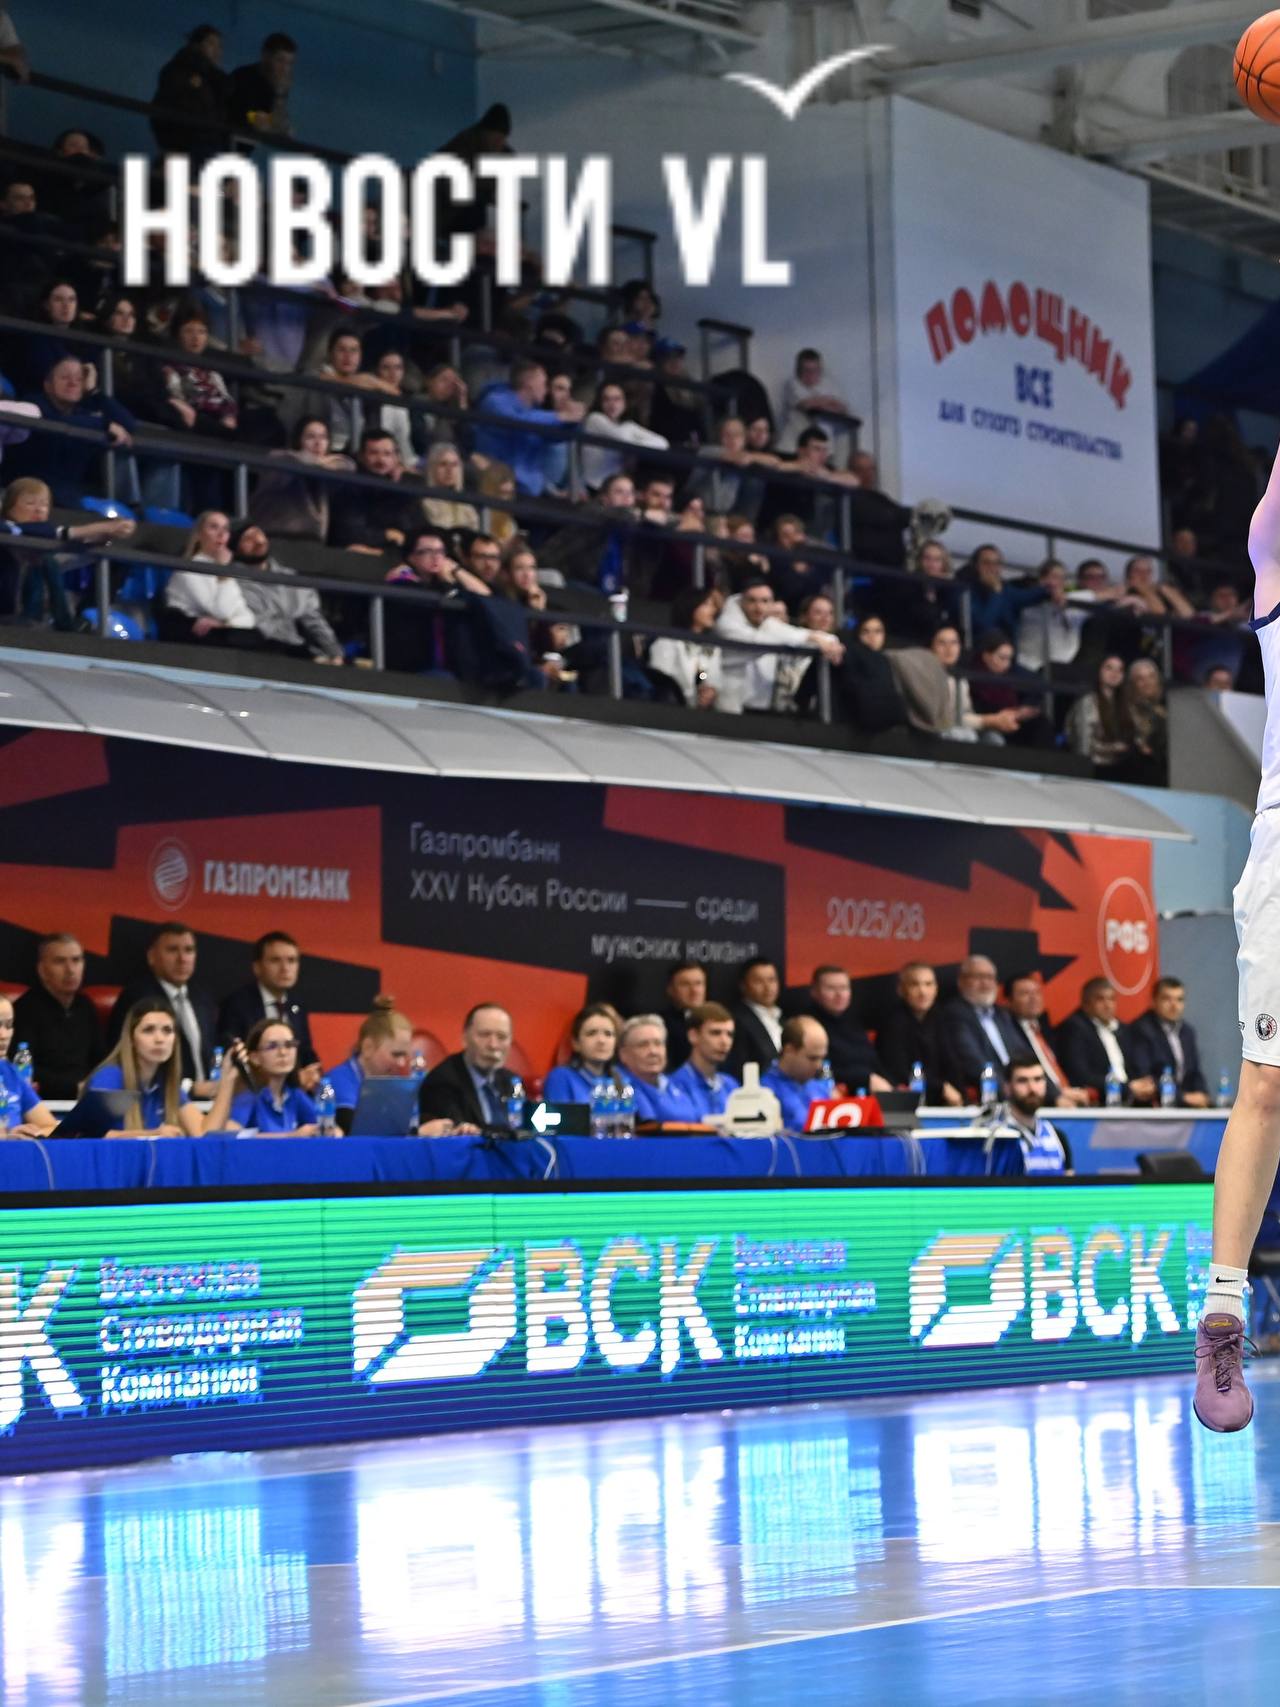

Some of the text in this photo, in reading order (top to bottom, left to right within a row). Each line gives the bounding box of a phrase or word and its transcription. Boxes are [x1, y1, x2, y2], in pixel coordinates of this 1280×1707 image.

[925, 279, 1133, 411] ПОМОЩНИК
[1015, 363, 1053, 410] ВСЕ
[204, 860, 350, 901] ГАЗПРОМБАНК
[546, 879, 628, 914] России
[1105, 918, 1150, 954] РФБ
[525, 1235, 723, 1377] ВСК
[1030, 1226, 1181, 1344] ВСК
